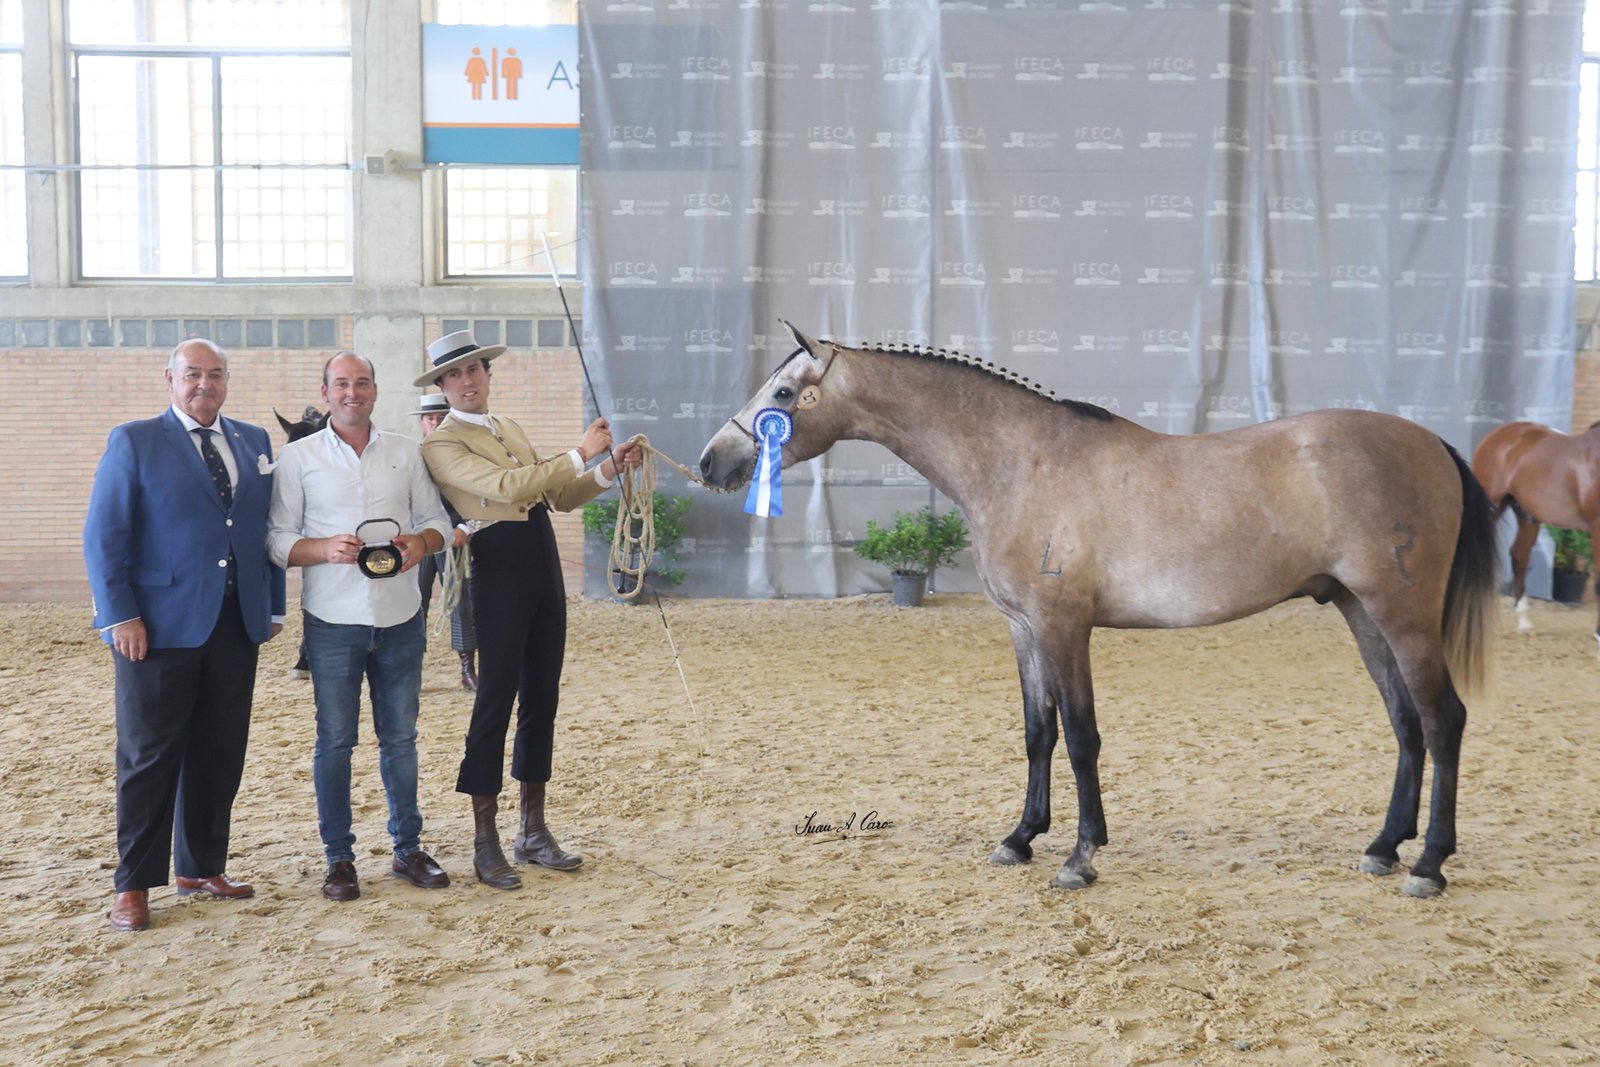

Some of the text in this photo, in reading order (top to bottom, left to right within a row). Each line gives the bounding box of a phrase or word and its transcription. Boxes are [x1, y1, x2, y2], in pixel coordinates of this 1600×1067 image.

[681, 56, 731, 70] IFECA
[1014, 57, 1064, 71] IFECA
[1147, 57, 1198, 71] IFECA
[608, 126, 657, 140] IFECA
[807, 126, 857, 140] IFECA
[939, 126, 987, 139] IFECA
[1075, 126, 1124, 140] IFECA
[1334, 129, 1385, 143] IFECA
[682, 193, 732, 207] IFECA
[882, 194, 931, 208] IFECA
[1012, 194, 1062, 208] IFECA
[1143, 194, 1193, 208] IFECA
[1268, 197, 1316, 211] IFECA
[1400, 197, 1448, 211] IFECA
[608, 262, 658, 276] IFECA
[807, 262, 856, 275] IFECA
[938, 262, 986, 275] IFECA
[1073, 262, 1121, 276] IFECA
[1330, 264, 1381, 279] IFECA
[684, 329, 733, 342] IFECA
[880, 329, 929, 343] IFECA
[1012, 330, 1060, 343] IFECA
[1142, 330, 1191, 343] IFECA
[1396, 331, 1447, 346] IFECA
[610, 398, 660, 411] IFECA
[802, 390, 817, 406] 27
[881, 463, 918, 476] IFEC
